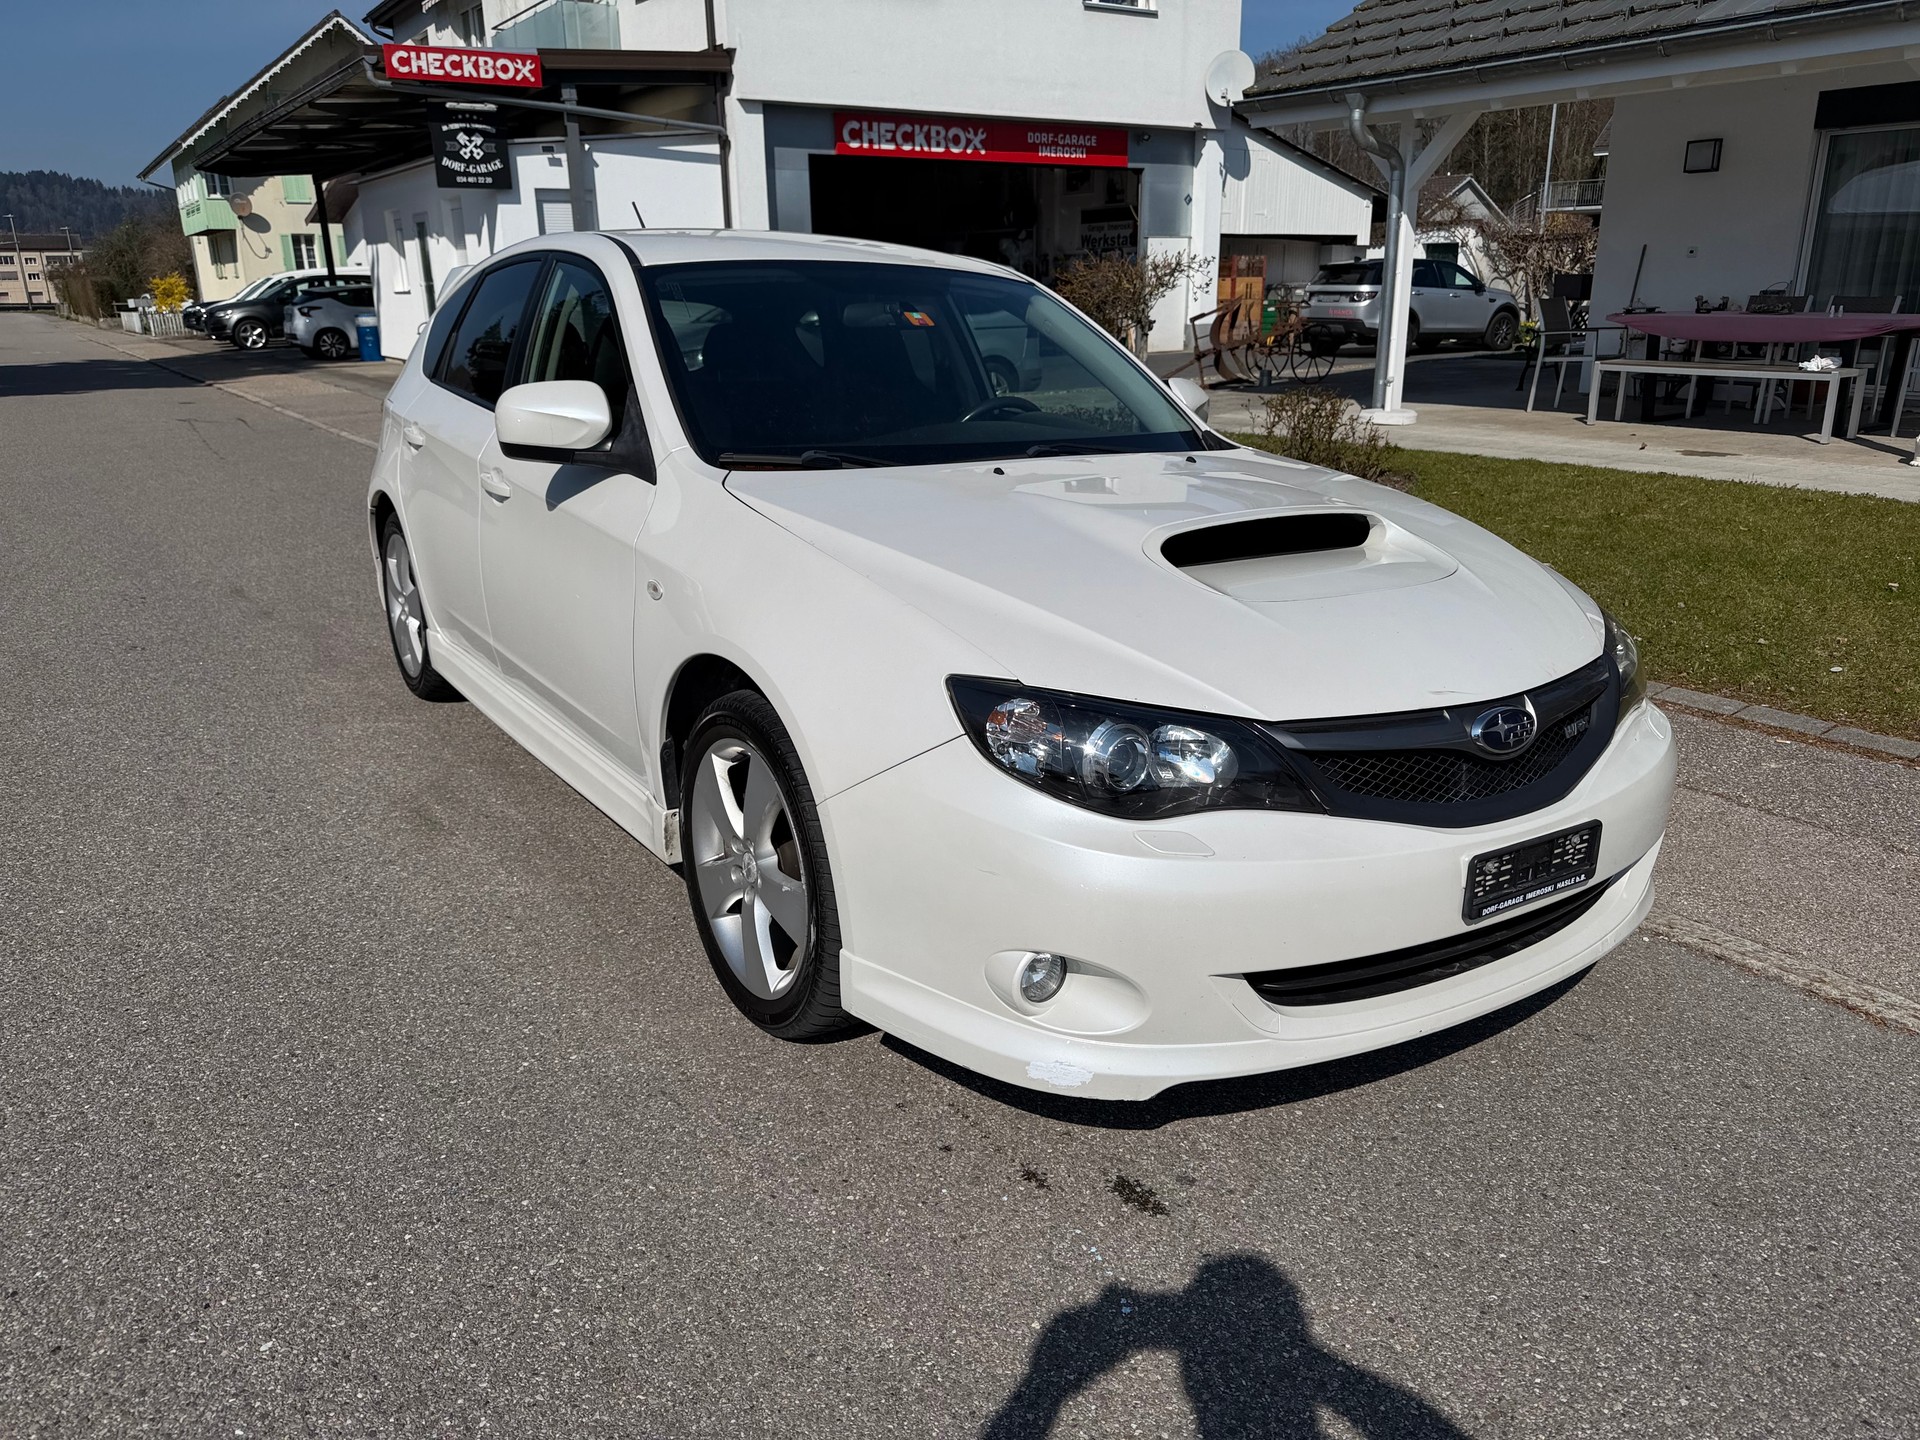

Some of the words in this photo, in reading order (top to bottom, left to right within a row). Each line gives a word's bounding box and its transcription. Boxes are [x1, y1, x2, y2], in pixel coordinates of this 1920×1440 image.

[391, 50, 536, 82] CHECKBOX
[842, 120, 987, 155] CHECKBOX
[1038, 145, 1087, 159] IMEROSKI
[441, 156, 504, 174] DORF-GARAGE
[1482, 894, 1524, 916] DORF-GARAGE
[1525, 885, 1554, 900] IMEROSKI
[1556, 877, 1575, 889] HASLE
